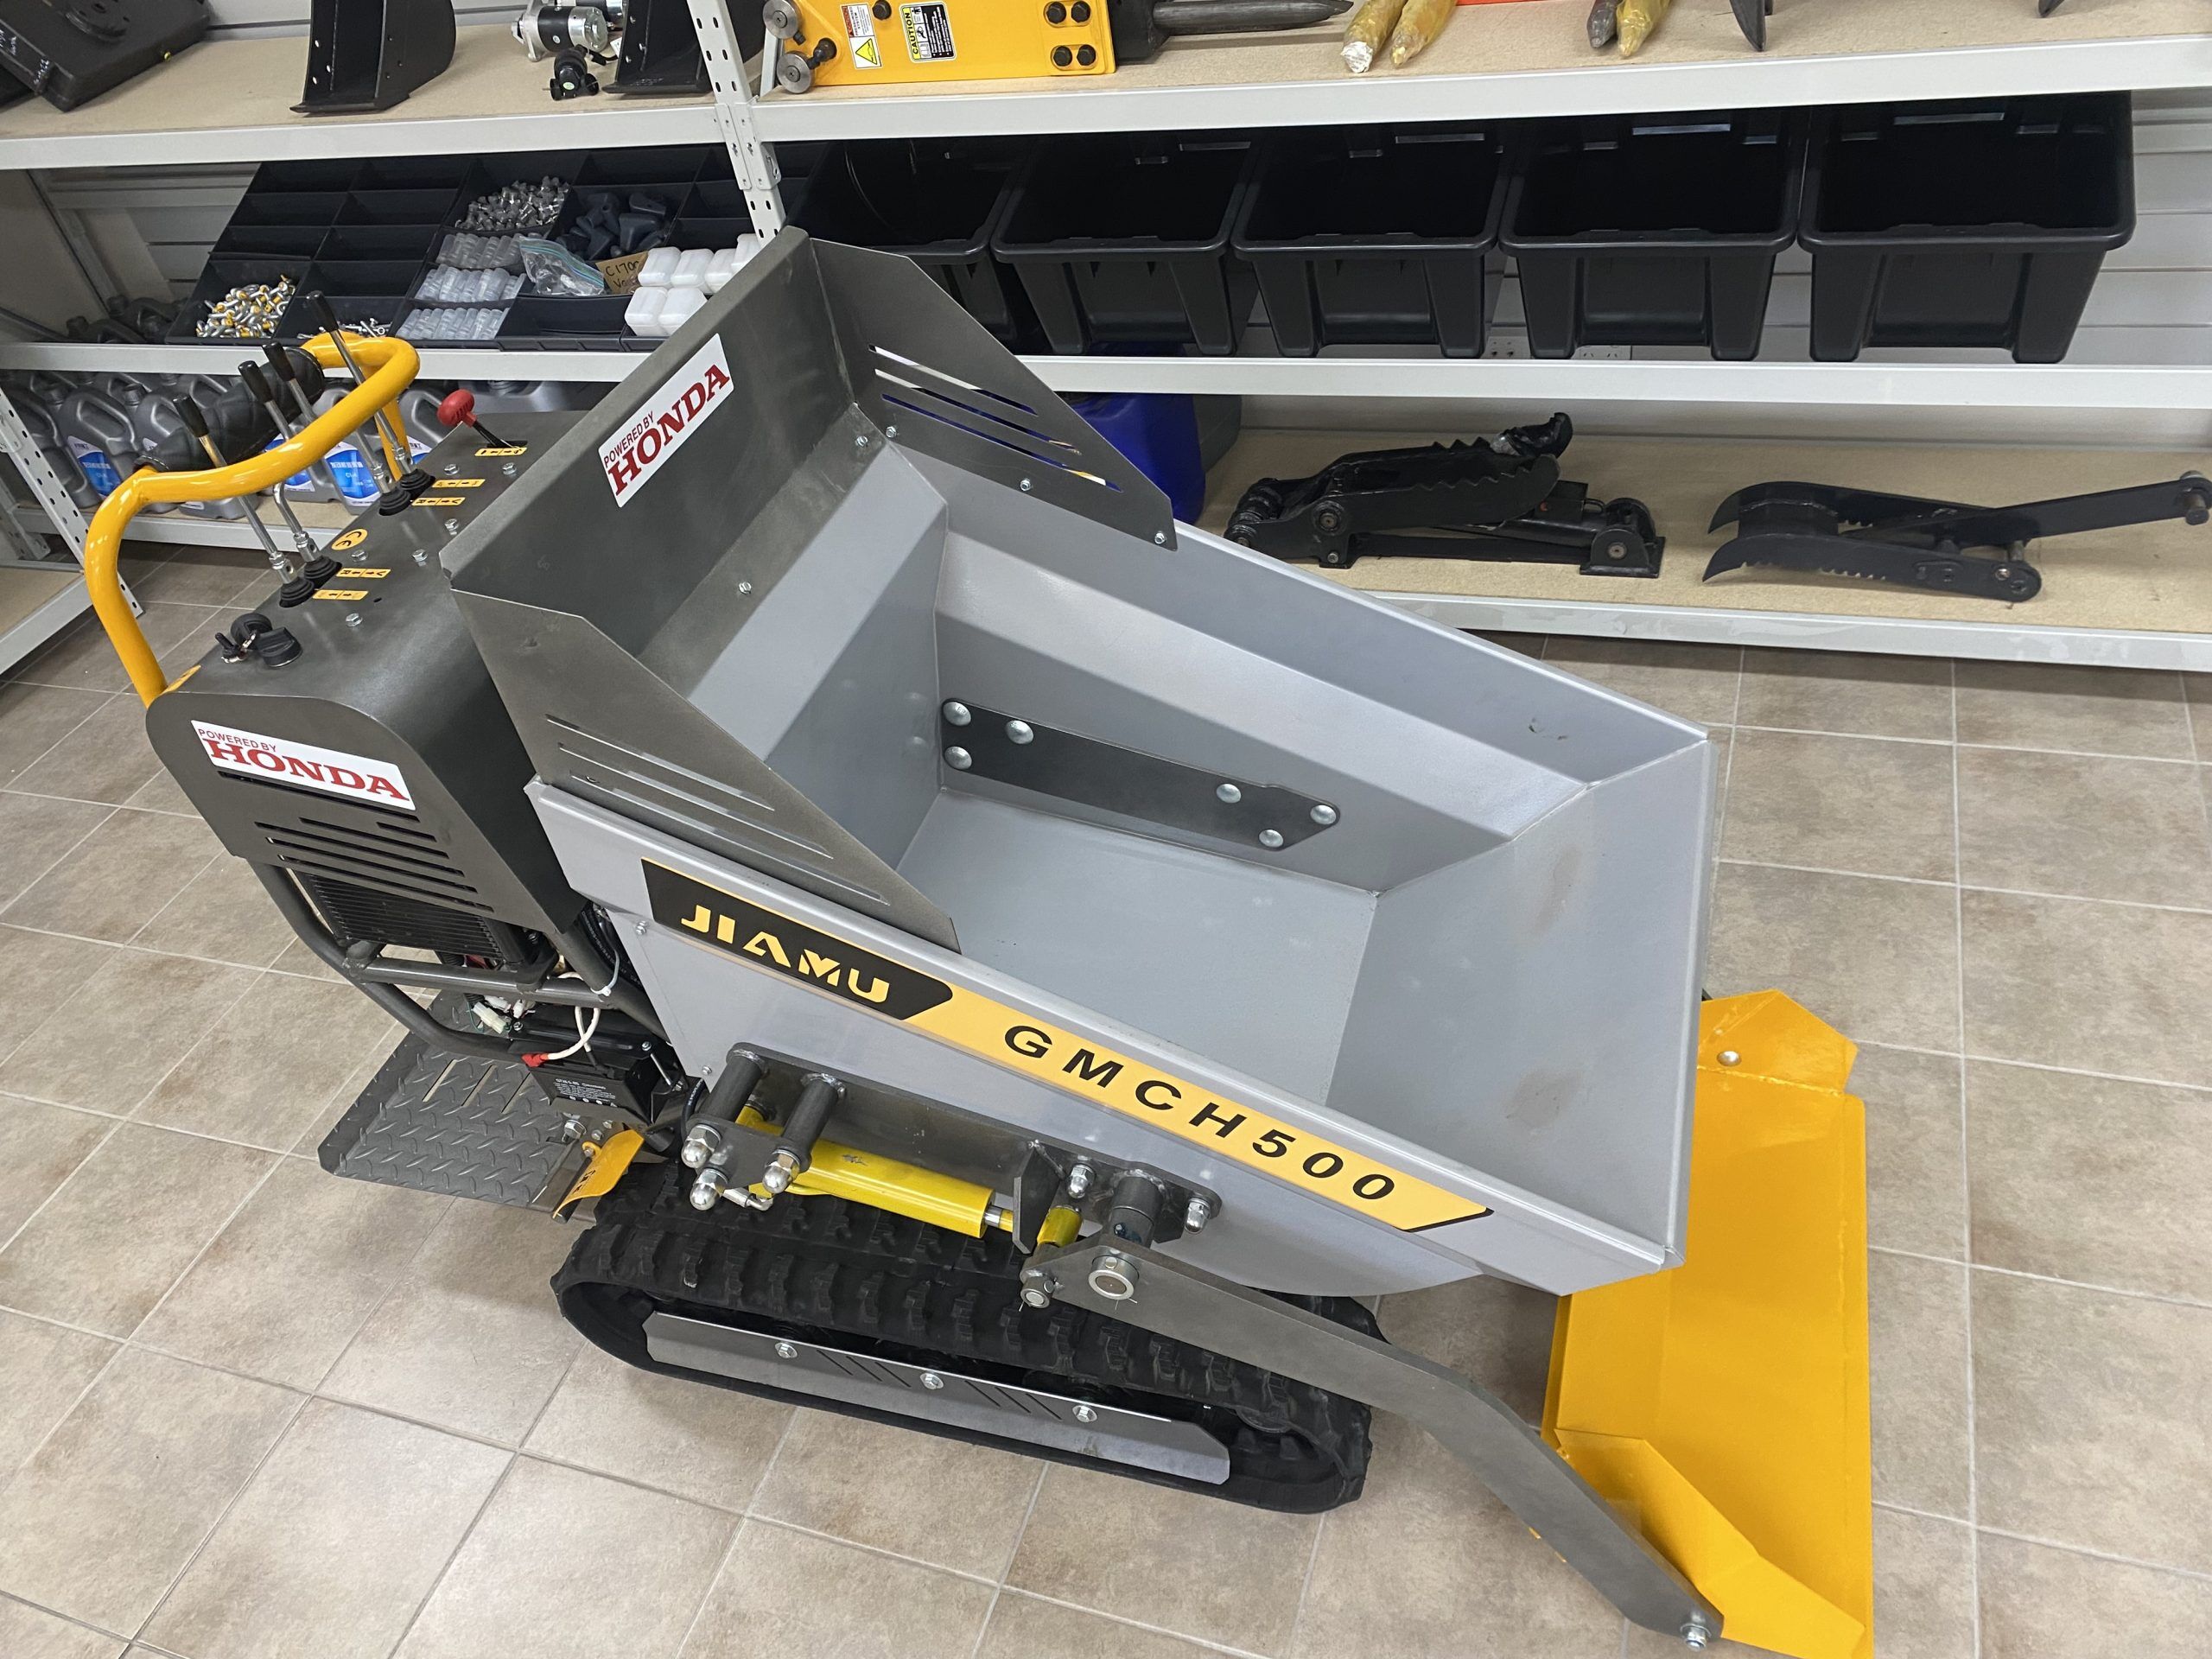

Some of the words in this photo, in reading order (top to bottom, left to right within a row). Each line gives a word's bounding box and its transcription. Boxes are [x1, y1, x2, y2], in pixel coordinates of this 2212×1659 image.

[905, 12, 918, 54] CAUTION
[604, 423, 644, 467] POWERED
[644, 411, 654, 429] BY
[608, 365, 730, 496] HONDA
[198, 728, 258, 749] POWERED
[261, 742, 276, 753] BY
[202, 739, 410, 802] HONDA
[681, 905, 890, 1003] JIAMU
[1004, 1025, 1395, 1200] GMCH500
